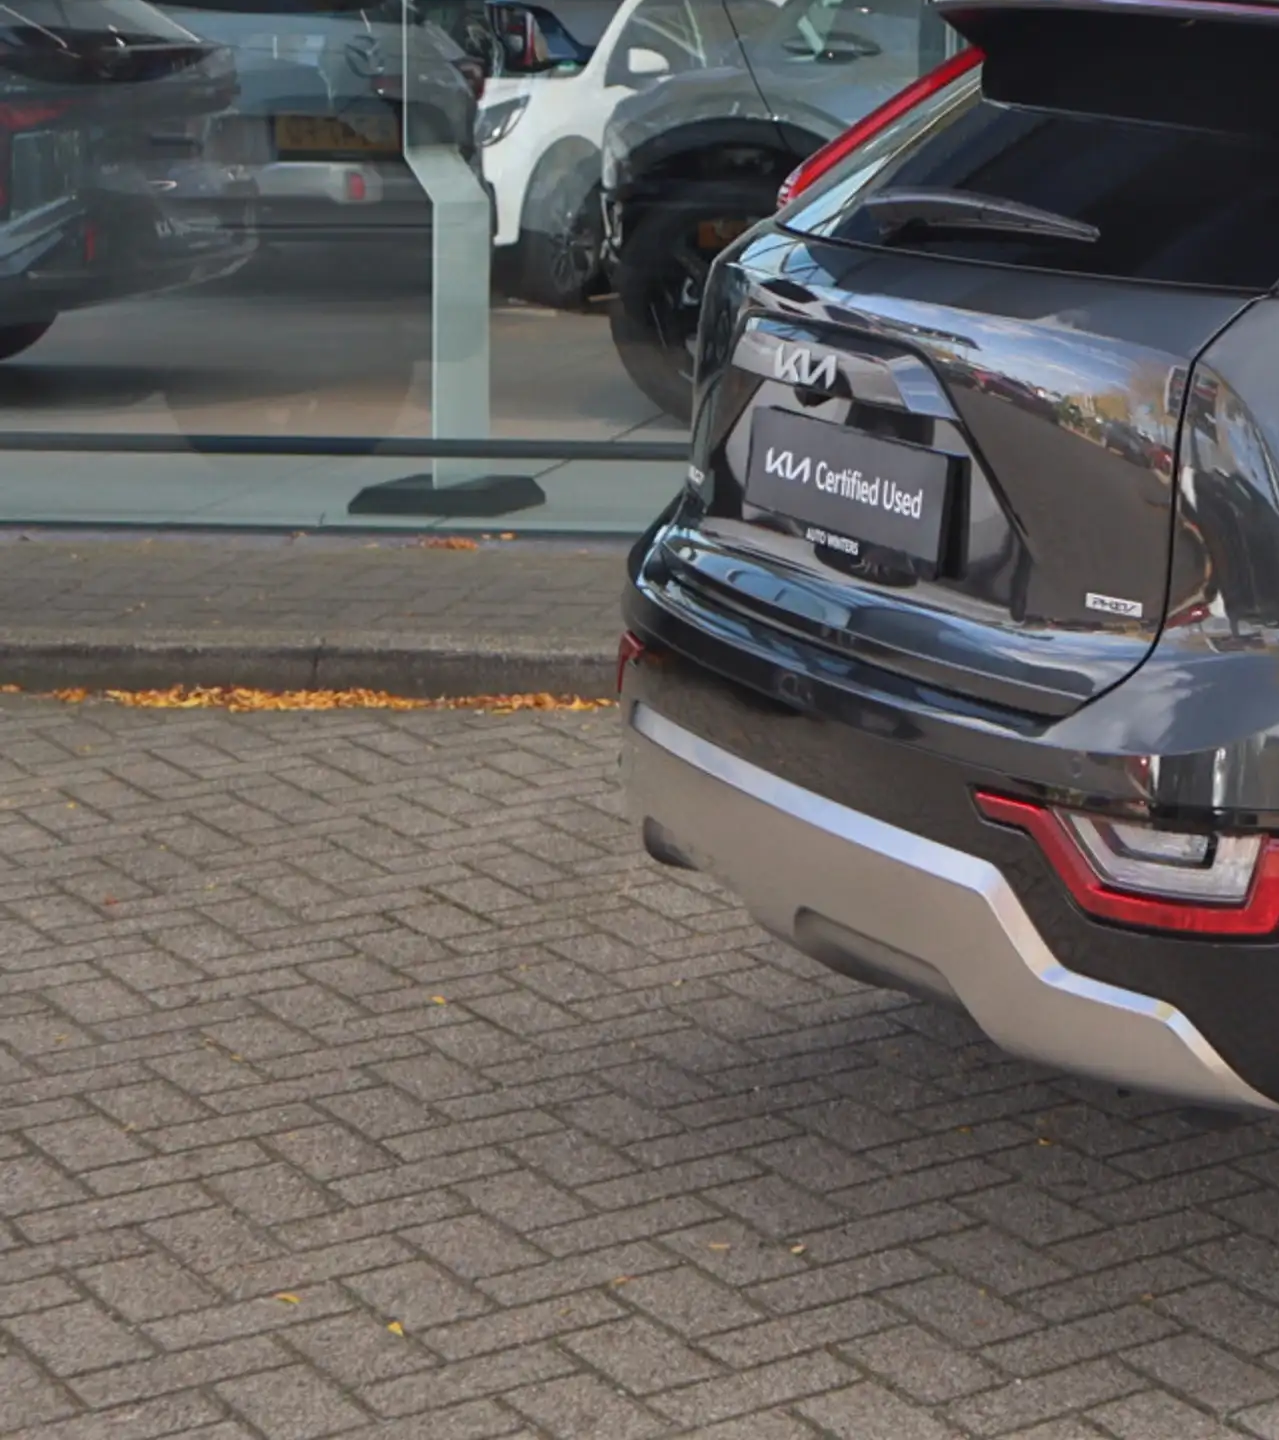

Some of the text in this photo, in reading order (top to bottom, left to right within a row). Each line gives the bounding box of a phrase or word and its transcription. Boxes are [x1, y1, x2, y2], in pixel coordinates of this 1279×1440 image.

[774, 343, 837, 389] KIA
[765, 447, 923, 519] KIA Certified Used
[806, 527, 859, 556] AUTO WINTERS
